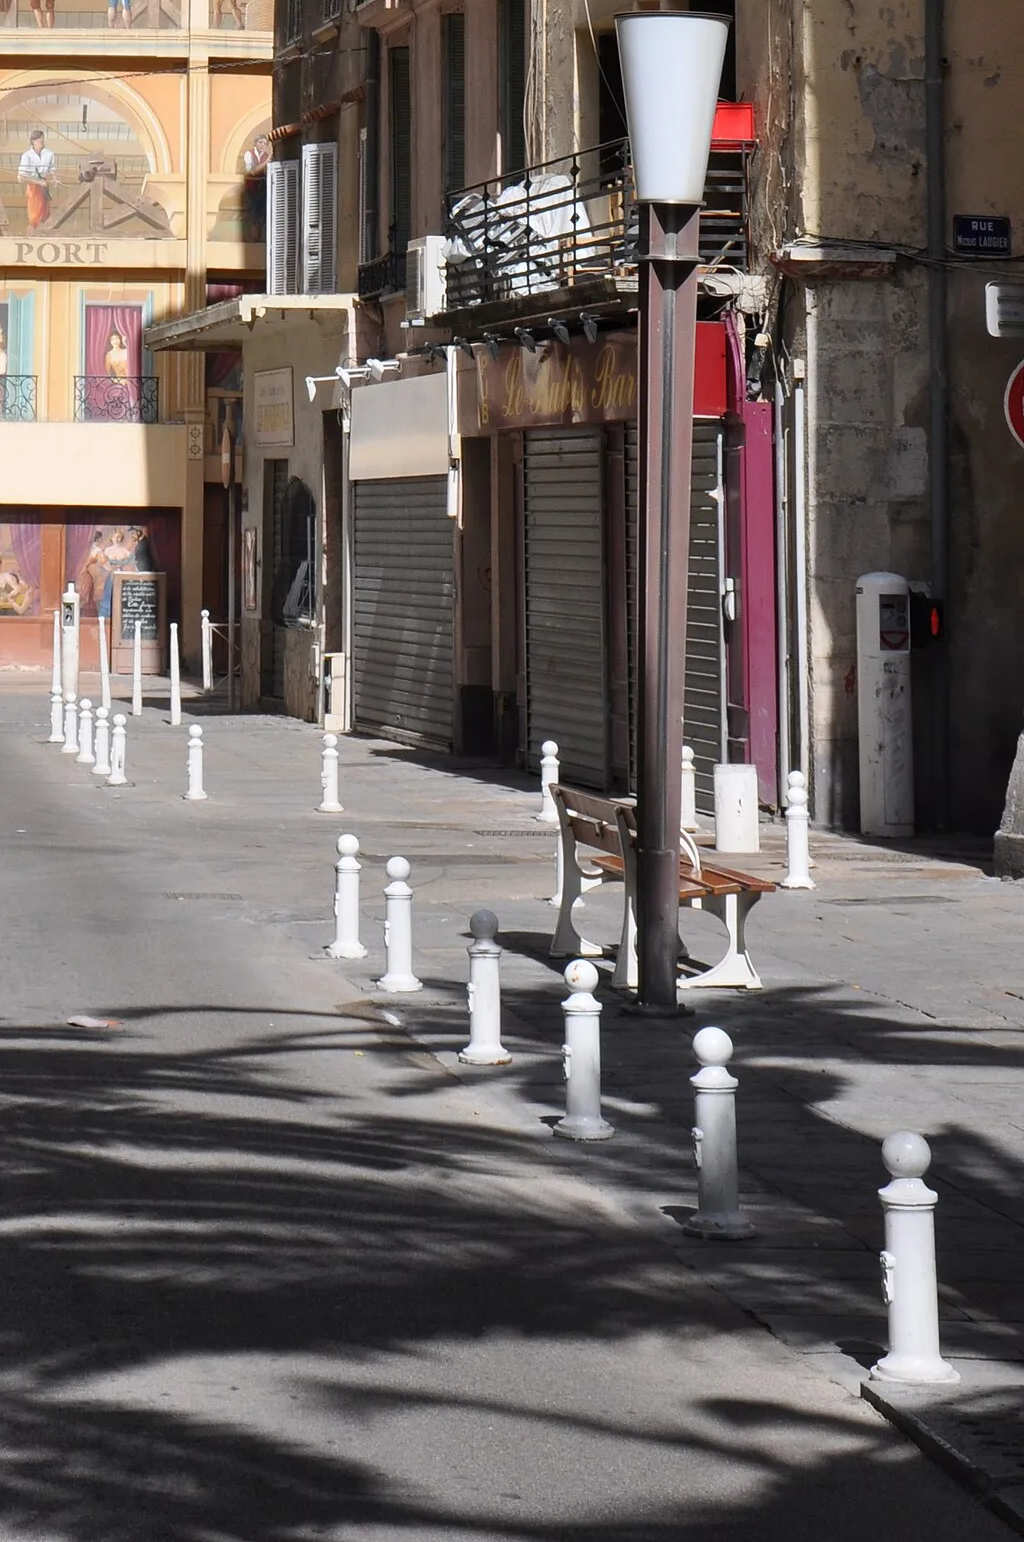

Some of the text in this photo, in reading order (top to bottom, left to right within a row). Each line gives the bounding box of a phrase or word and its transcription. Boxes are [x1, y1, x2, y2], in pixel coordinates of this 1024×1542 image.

[971, 221, 994, 231] RUE
[15, 242, 108, 264] PORT
[590, 344, 637, 409] Bar
